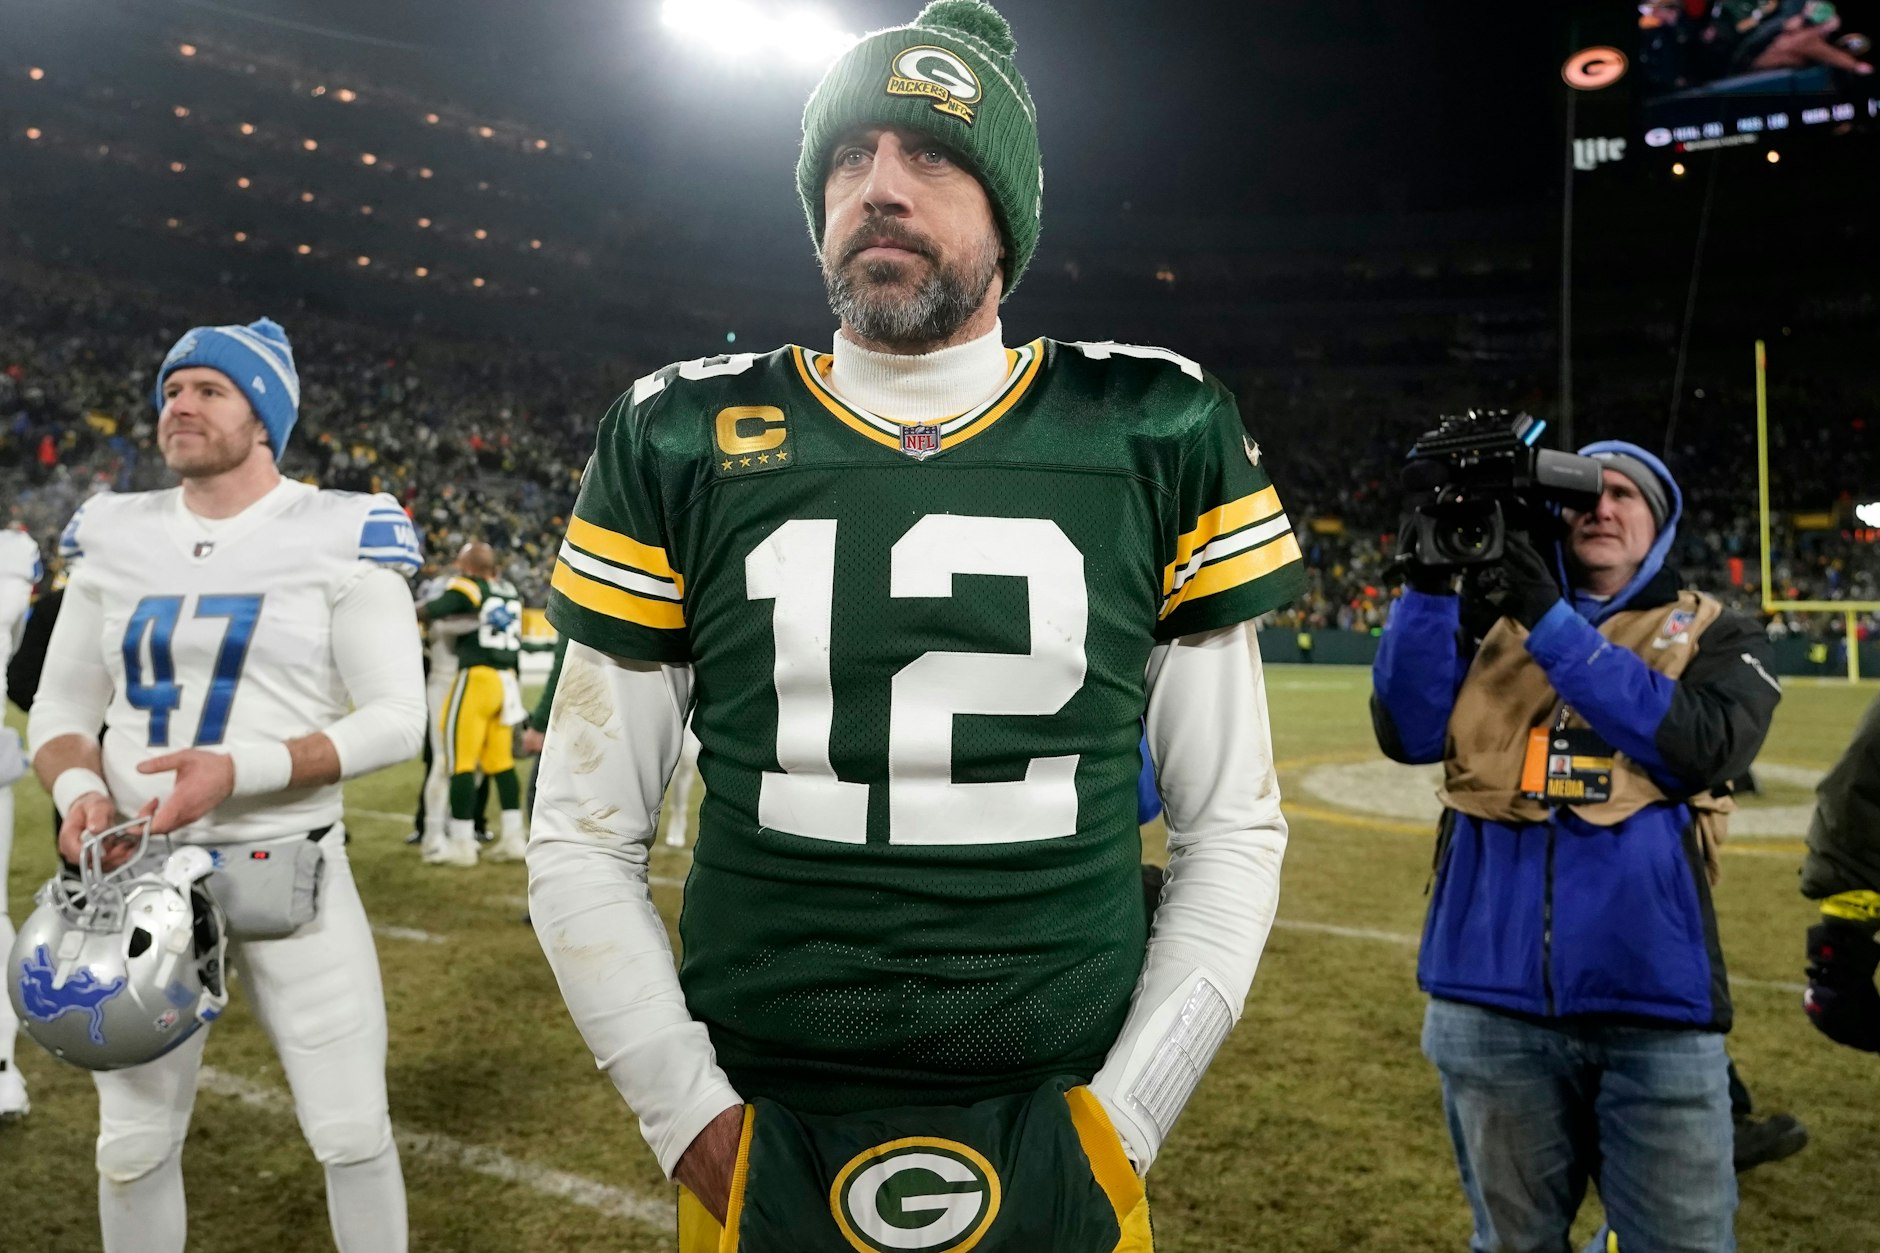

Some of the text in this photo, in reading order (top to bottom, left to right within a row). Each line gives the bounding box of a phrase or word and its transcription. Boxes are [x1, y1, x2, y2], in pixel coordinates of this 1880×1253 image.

[890, 79, 946, 97] PACKERS
[899, 49, 976, 98] G
[948, 101, 967, 115] NFC
[716, 406, 787, 455] C
[906, 435, 935, 450] NFL
[122, 593, 266, 747] 47
[745, 514, 1088, 845] 12
[1547, 779, 1585, 797] MEDIA
[848, 1153, 982, 1249] G
